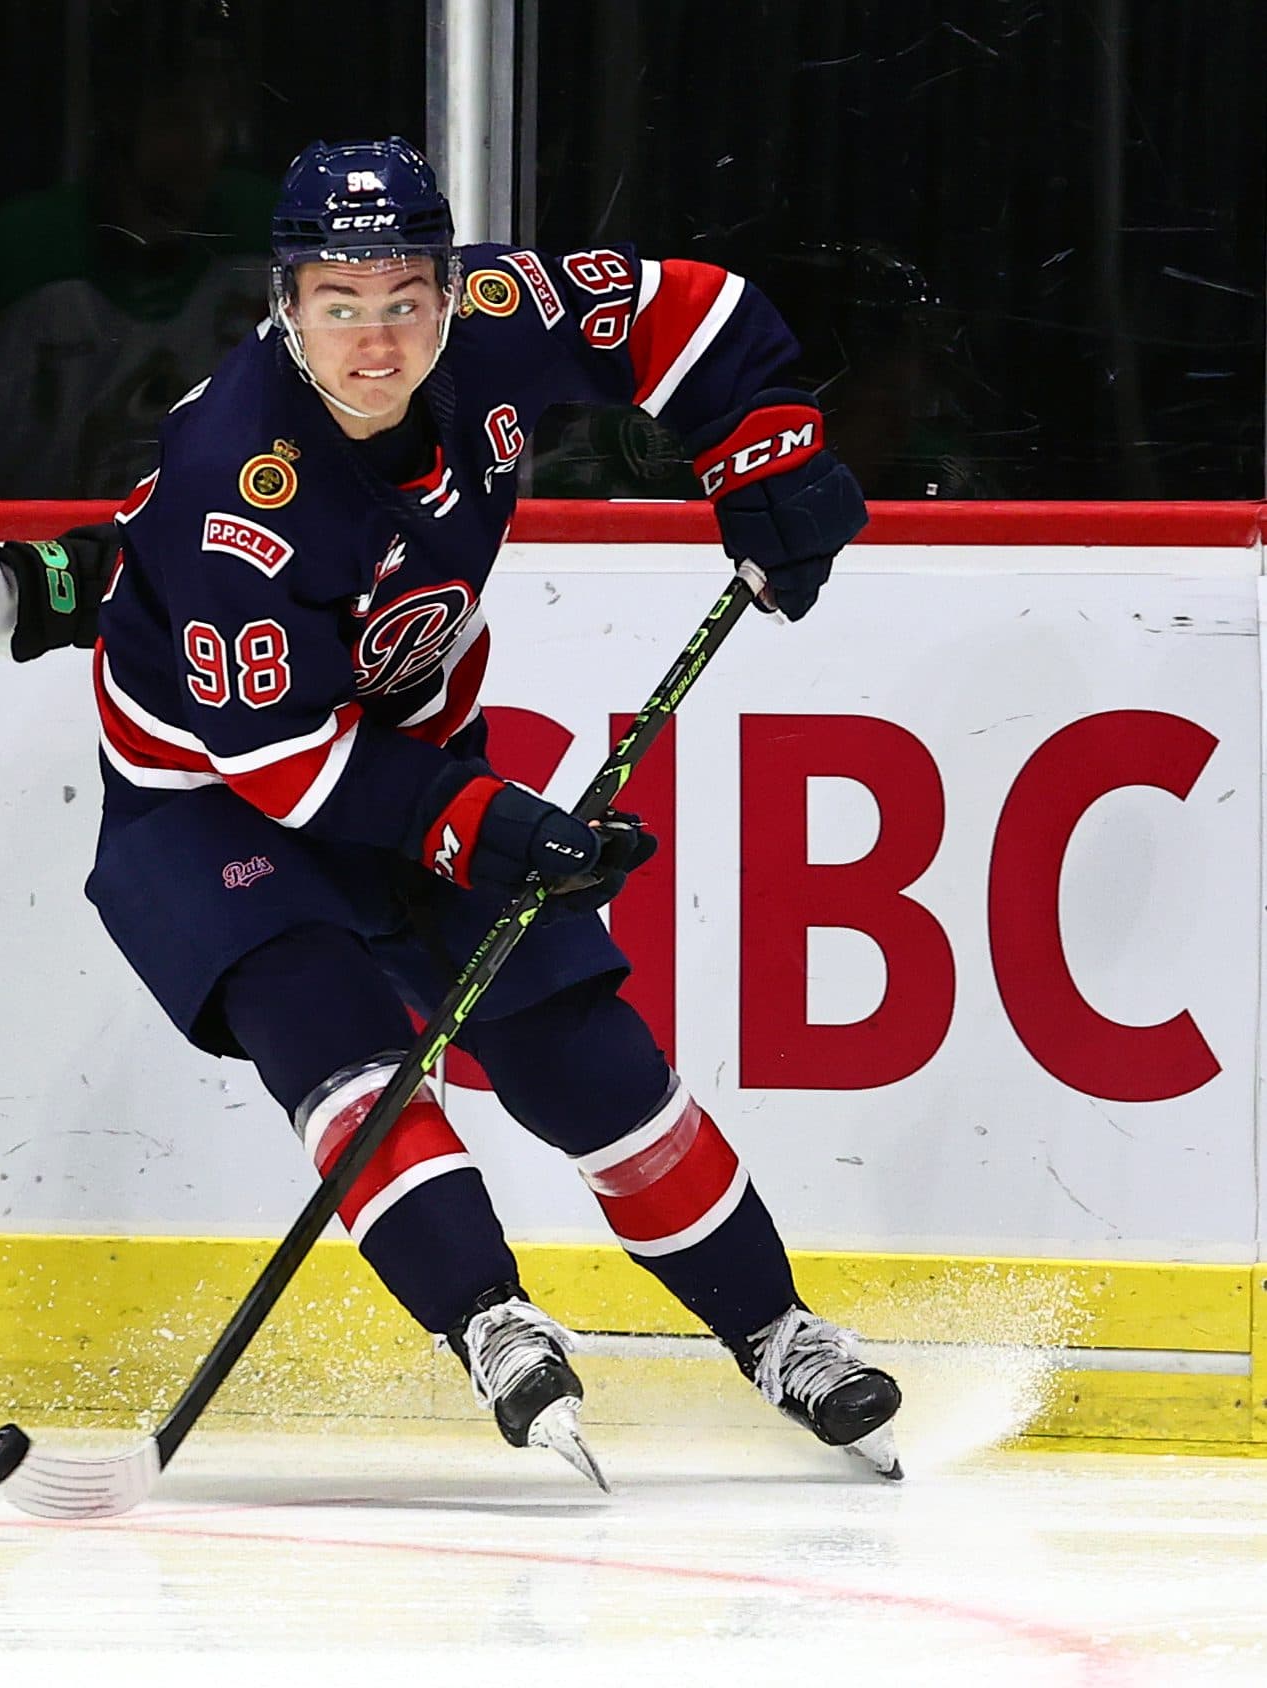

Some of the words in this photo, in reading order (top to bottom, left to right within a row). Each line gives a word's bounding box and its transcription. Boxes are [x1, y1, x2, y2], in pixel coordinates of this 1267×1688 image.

[332, 213, 396, 230] CCM
[484, 403, 524, 463] C
[701, 422, 815, 497] CCM
[184, 618, 291, 709] 98
